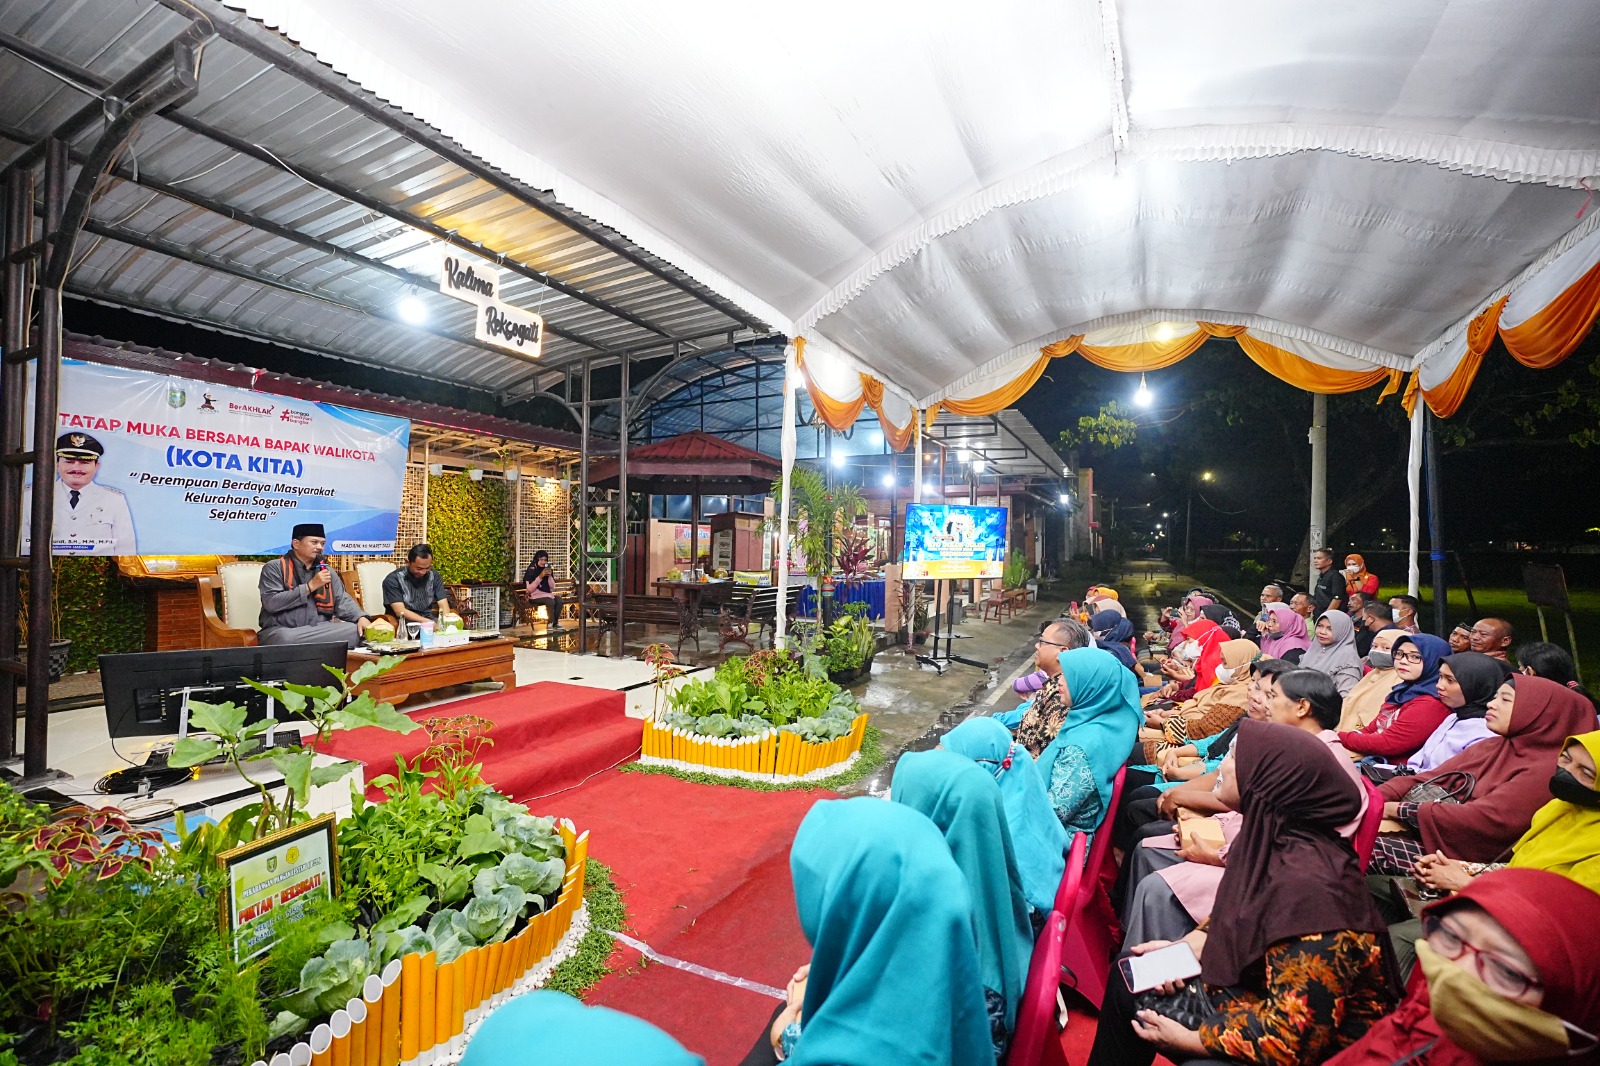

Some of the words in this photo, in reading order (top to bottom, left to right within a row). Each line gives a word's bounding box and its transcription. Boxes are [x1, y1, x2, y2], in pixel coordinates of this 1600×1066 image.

[445, 257, 494, 297] Kalima
[229, 402, 272, 415] BerAKHLAK
[59, 413, 122, 431] TATAP
[126, 421, 181, 439] MUKA
[185, 428, 260, 448] BERSAMA
[264, 438, 310, 454] BAPAK
[313, 444, 376, 462] WALIKOTA
[166, 445, 242, 471] (KOTA
[249, 456, 303, 478] KITA)
[184, 491, 249, 505] Kelurahan
[252, 496, 297, 509] Sogaten
[222, 479, 271, 493] Berdaya
[274, 483, 335, 497] Masyarakat
[238, 895, 273, 926] POKTAN
